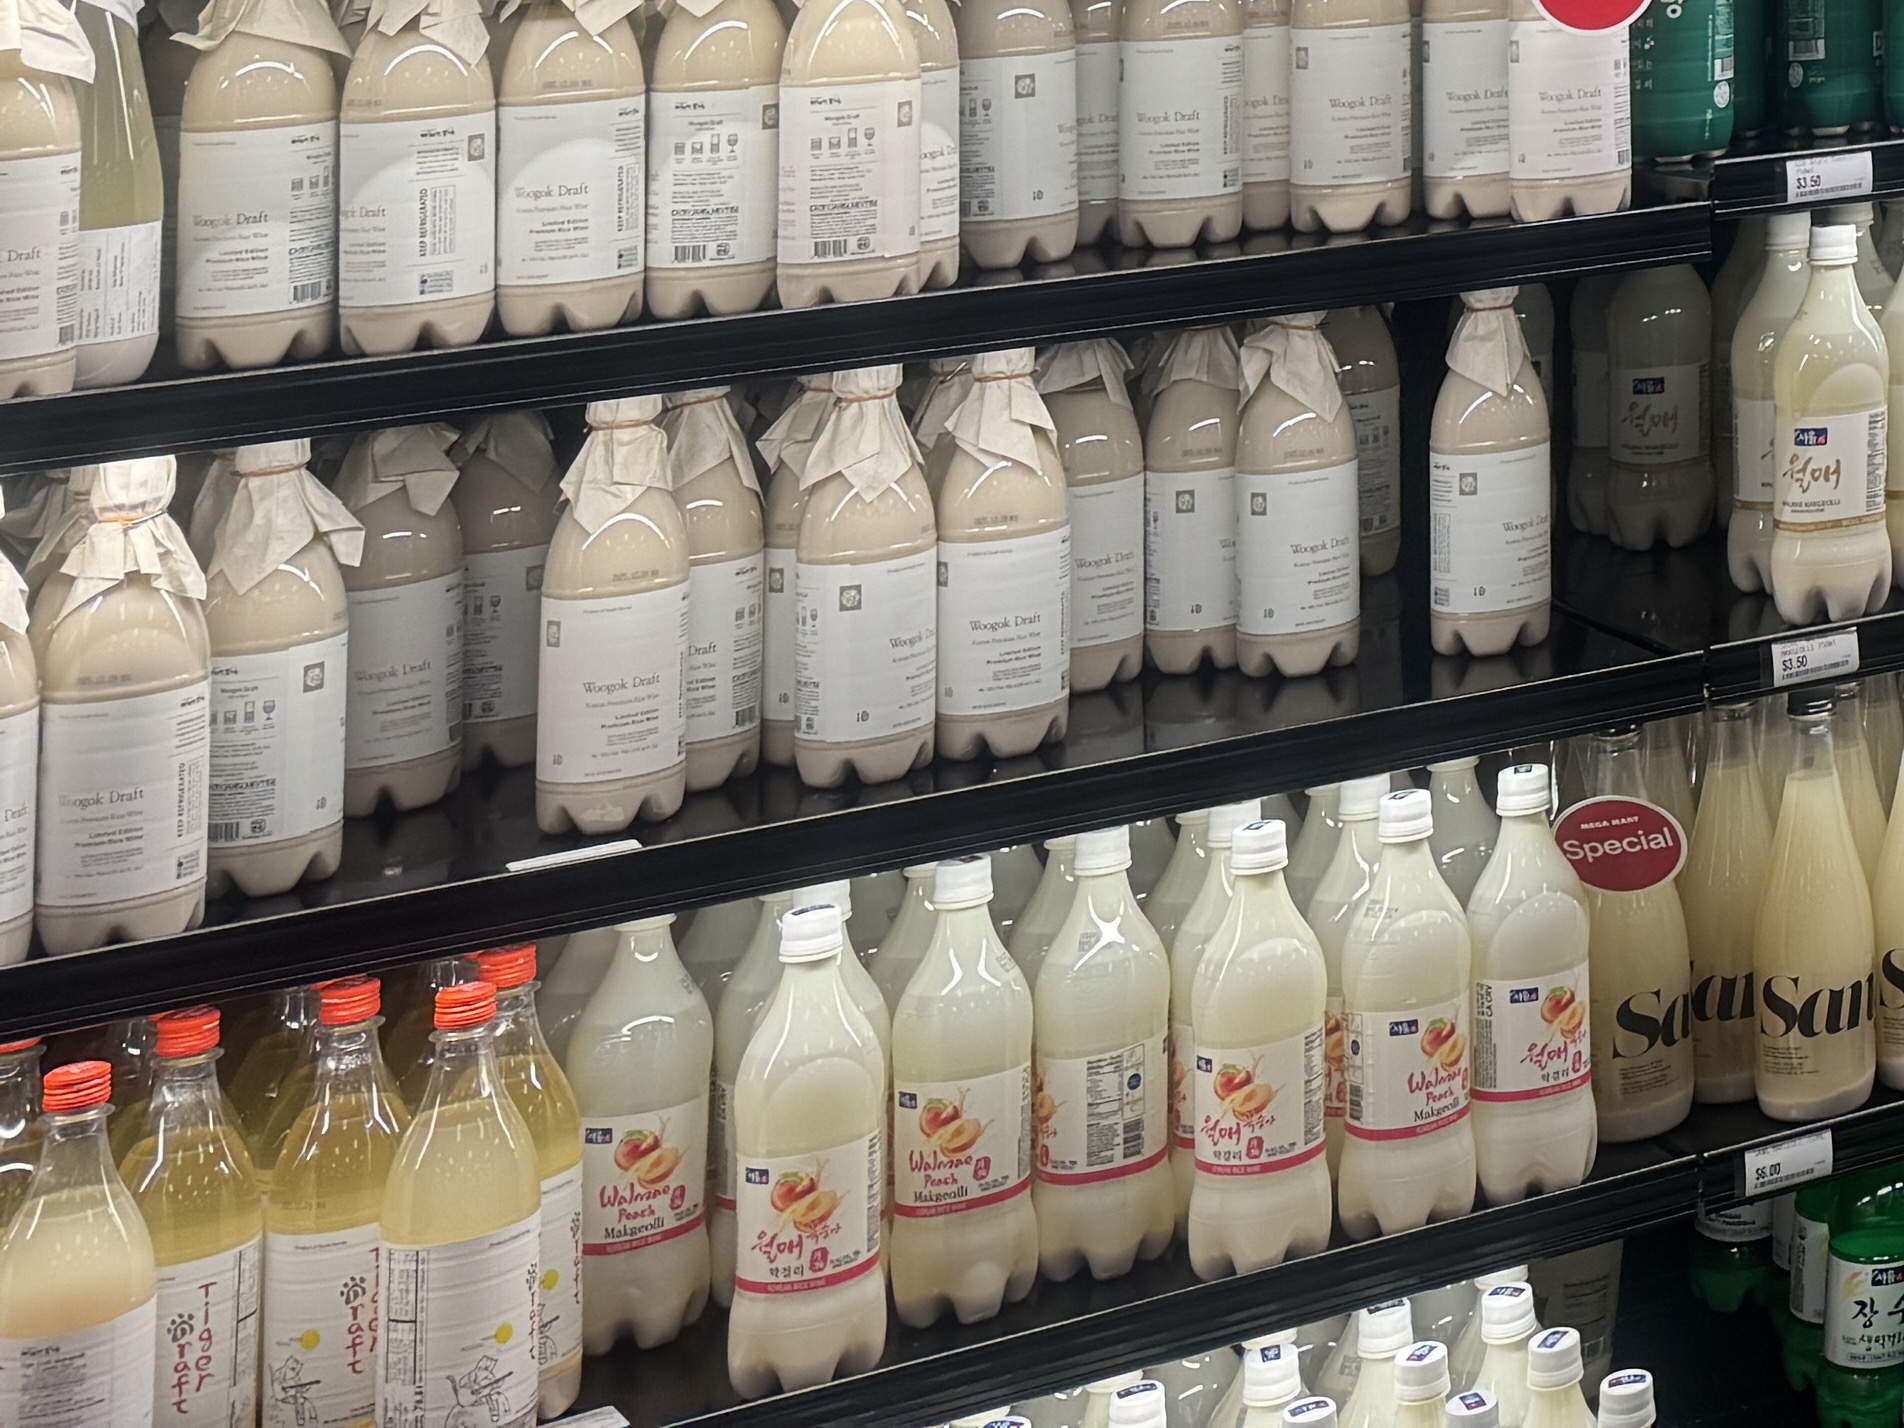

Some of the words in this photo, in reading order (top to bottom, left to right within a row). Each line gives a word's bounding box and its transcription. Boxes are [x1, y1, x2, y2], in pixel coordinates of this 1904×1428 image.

[1370, 93, 1392, 106] Draft
[1175, 110, 1200, 123] Draft
[558, 182, 589, 197] Draft
[1783, 454, 1841, 493] 월매
[1289, 540, 1328, 556] Woogok
[970, 616, 1010, 633] Woogok
[1014, 612, 1041, 629] Draft
[1781, 656, 1808, 672] $3.50
[583, 679, 629, 695] Woogok
[632, 672, 661, 688] Draft
[109, 786, 145, 804] Draft
[1581, 819, 1608, 831] MEGA
[1612, 815, 1639, 827] MART
[1562, 826, 1674, 862] Special
[1759, 972, 1876, 1039] San
[1520, 1041, 1569, 1069] 월매
[1425, 1087, 1455, 1106] Peach
[1414, 1099, 1461, 1123] Makgeolli
[1201, 1116, 1242, 1145] 월매
[909, 1150, 973, 1174] Walmae
[924, 1170, 958, 1187] Peach
[600, 1184, 671, 1209] Walmae
[914, 1185, 969, 1205] Makgeolli
[618, 1206, 656, 1223] Peach
[604, 1218, 665, 1241] Makgeolli
[752, 1230, 804, 1264] 월매
[768, 1263, 805, 1280] 막걸리
[197, 1281, 217, 1393] Tiger
